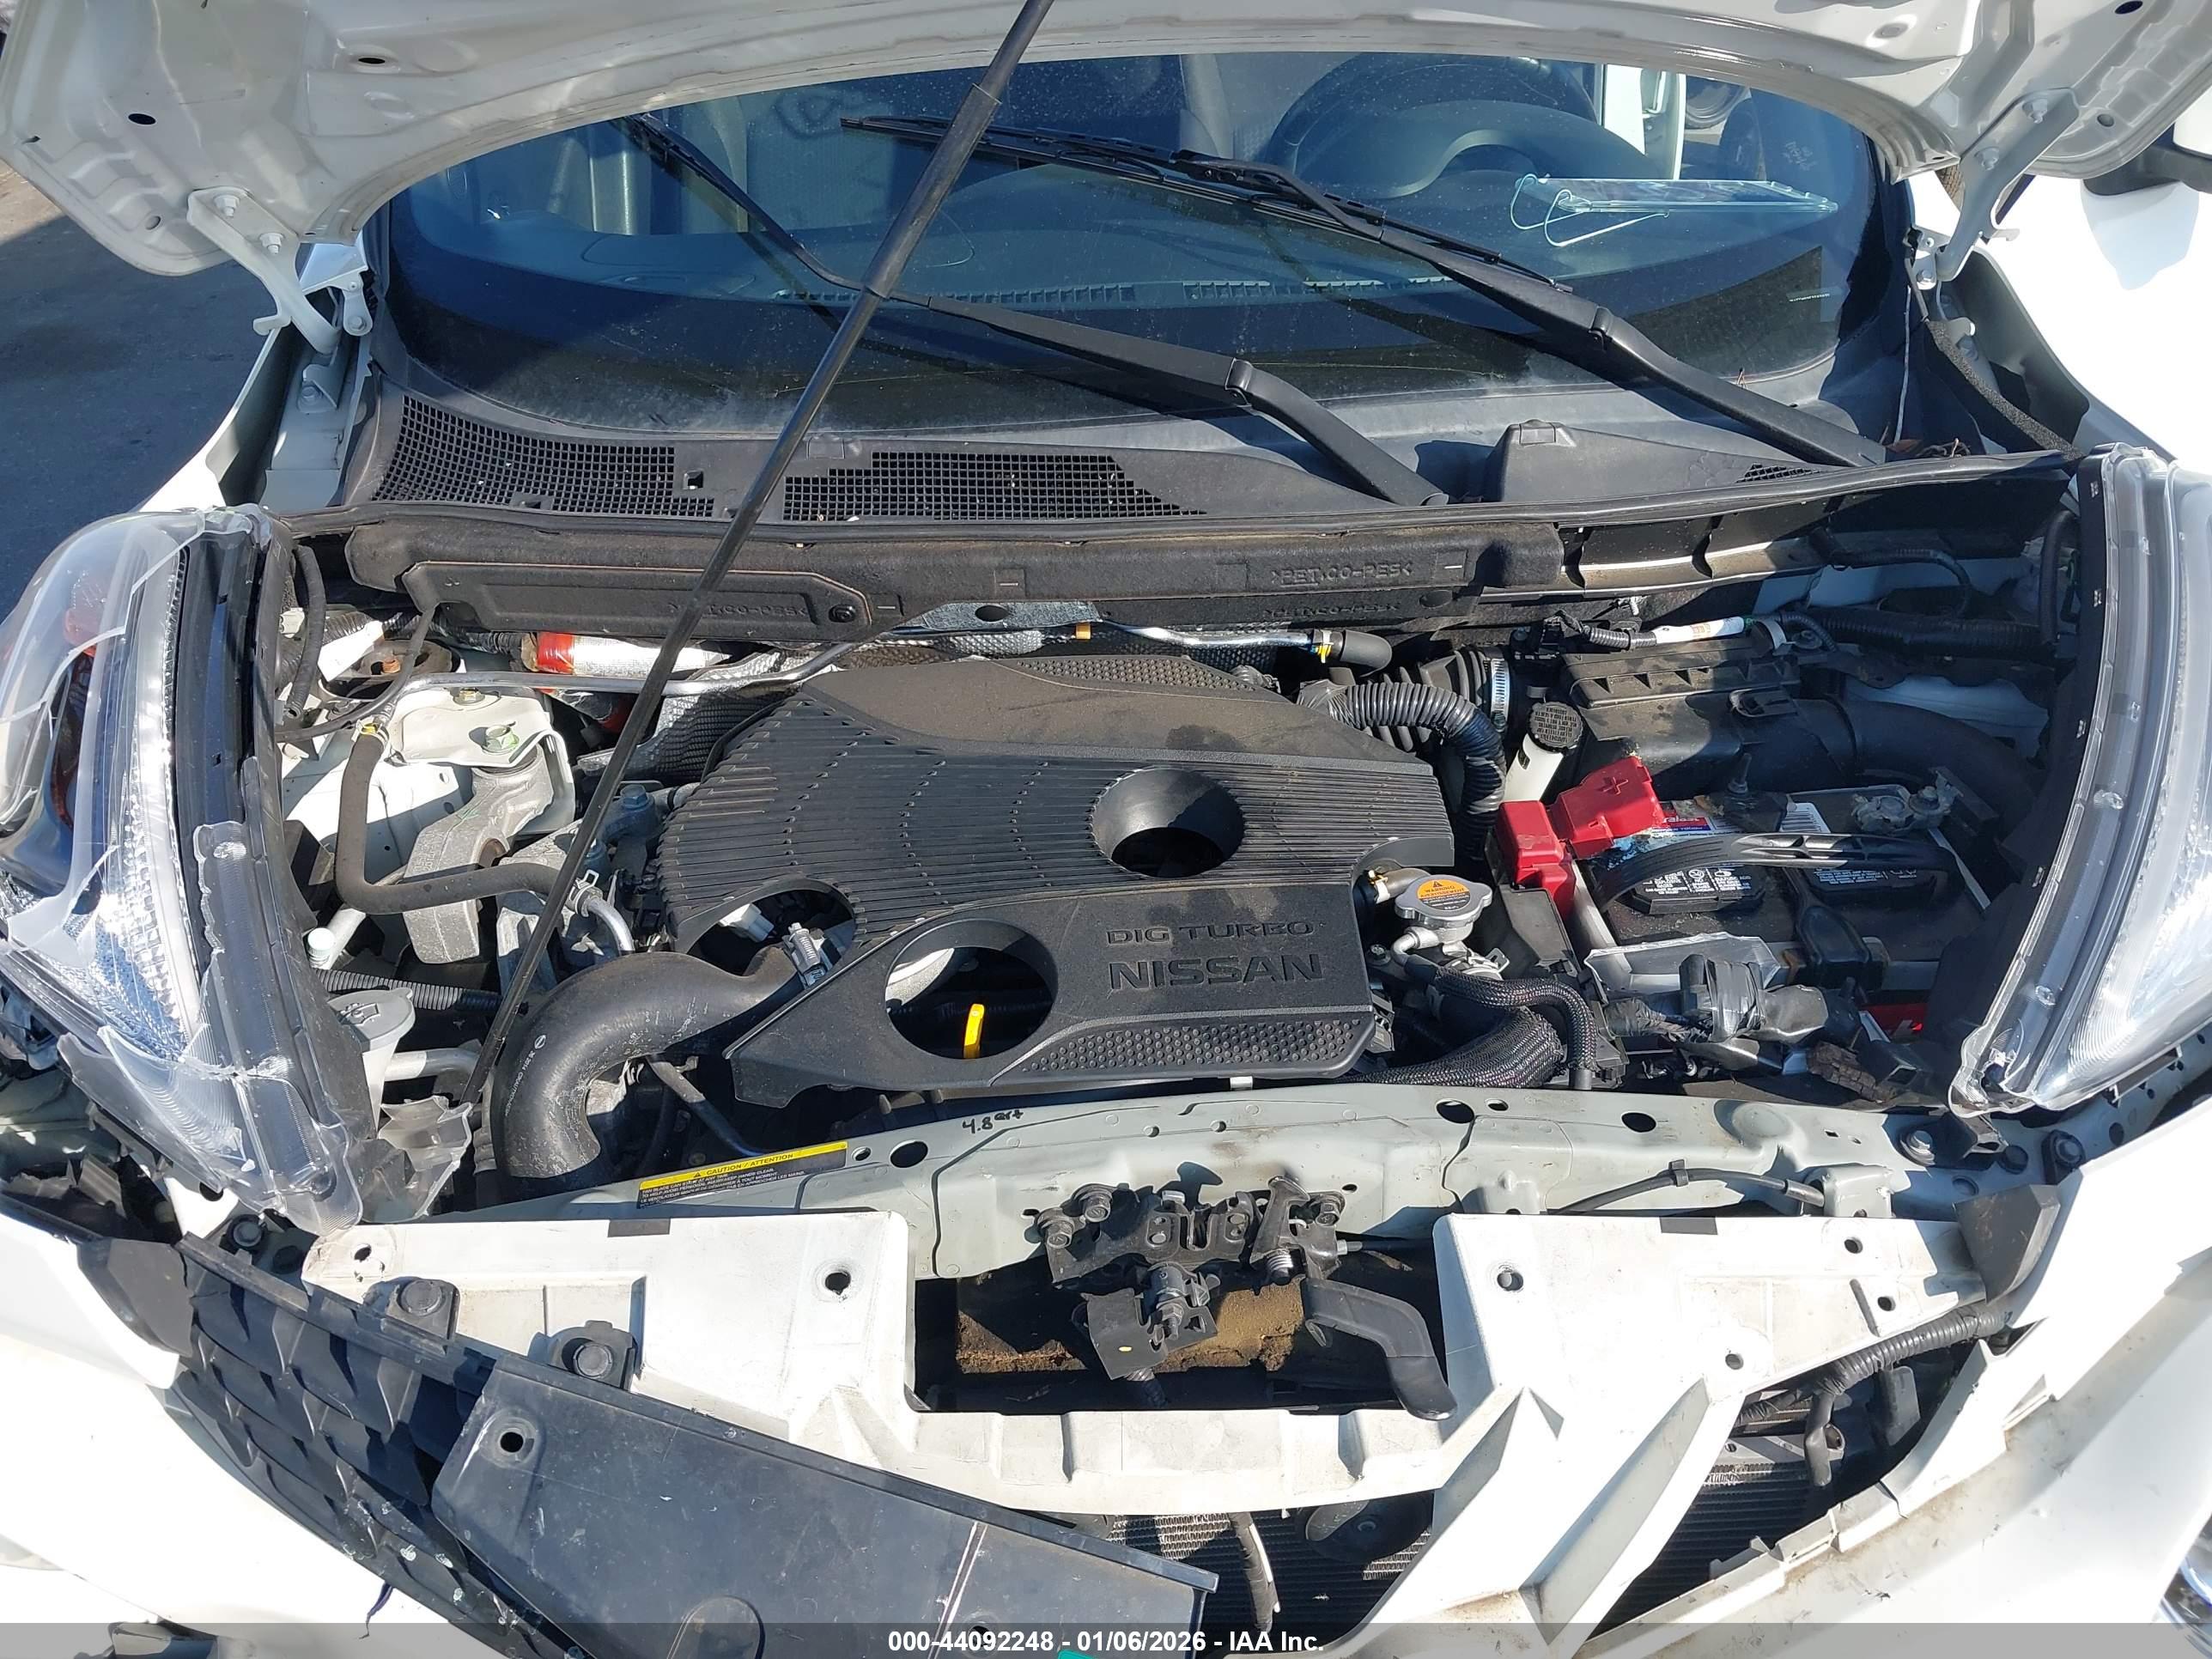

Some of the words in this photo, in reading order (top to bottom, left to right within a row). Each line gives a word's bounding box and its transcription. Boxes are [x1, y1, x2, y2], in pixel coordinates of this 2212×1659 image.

[1106, 927, 1170, 945] DIG
[1179, 921, 1315, 940] TURBO
[1108, 953, 1324, 990] NISSAN
[962, 1116, 994, 1134] 4.8
[706, 1163, 741, 1175] CAUTION
[750, 1152, 793, 1166] ATTENTION
